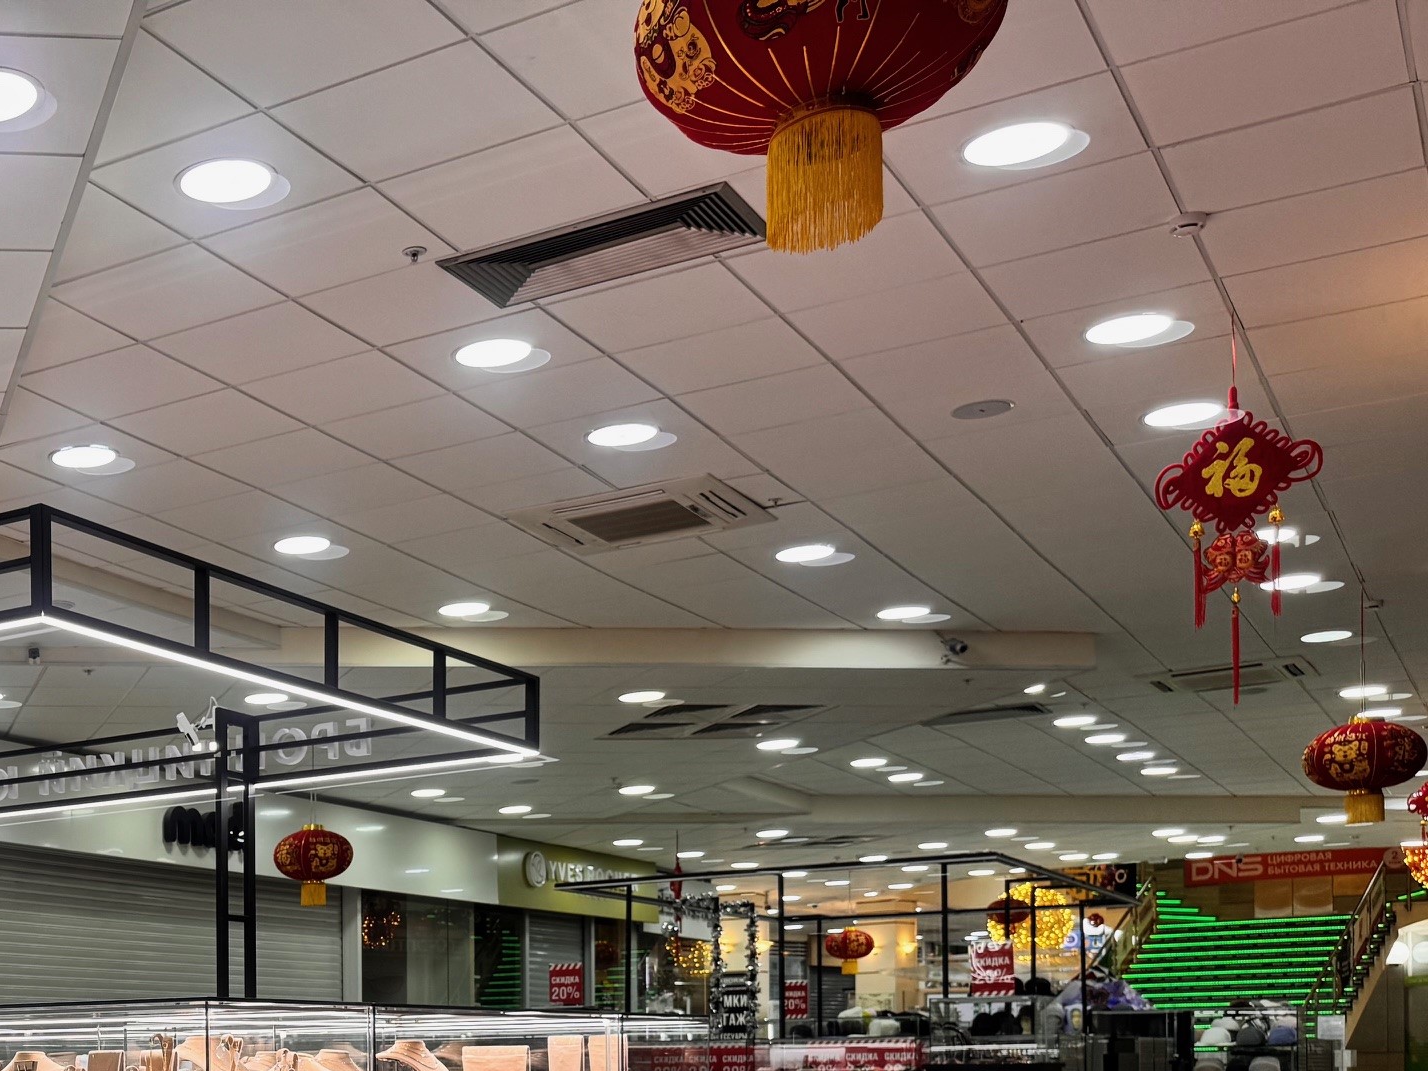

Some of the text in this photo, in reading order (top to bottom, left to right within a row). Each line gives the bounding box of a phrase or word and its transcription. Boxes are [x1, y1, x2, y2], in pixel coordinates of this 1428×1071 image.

[1201, 437, 1263, 498] 福
[1268, 851, 1332, 865] ЦИФРОВАЯ
[549, 861, 584, 883] YVES
[1191, 856, 1264, 881] DNS
[1268, 859, 1377, 875] БЫТОВАЯ ТЕХНИКА
[551, 975, 580, 985] СКИДКА
[551, 986, 580, 1000] 20%
[723, 993, 748, 1009] МКИ
[722, 1012, 747, 1027] ГАЖ
[845, 1052, 879, 1061] СКИДКА
